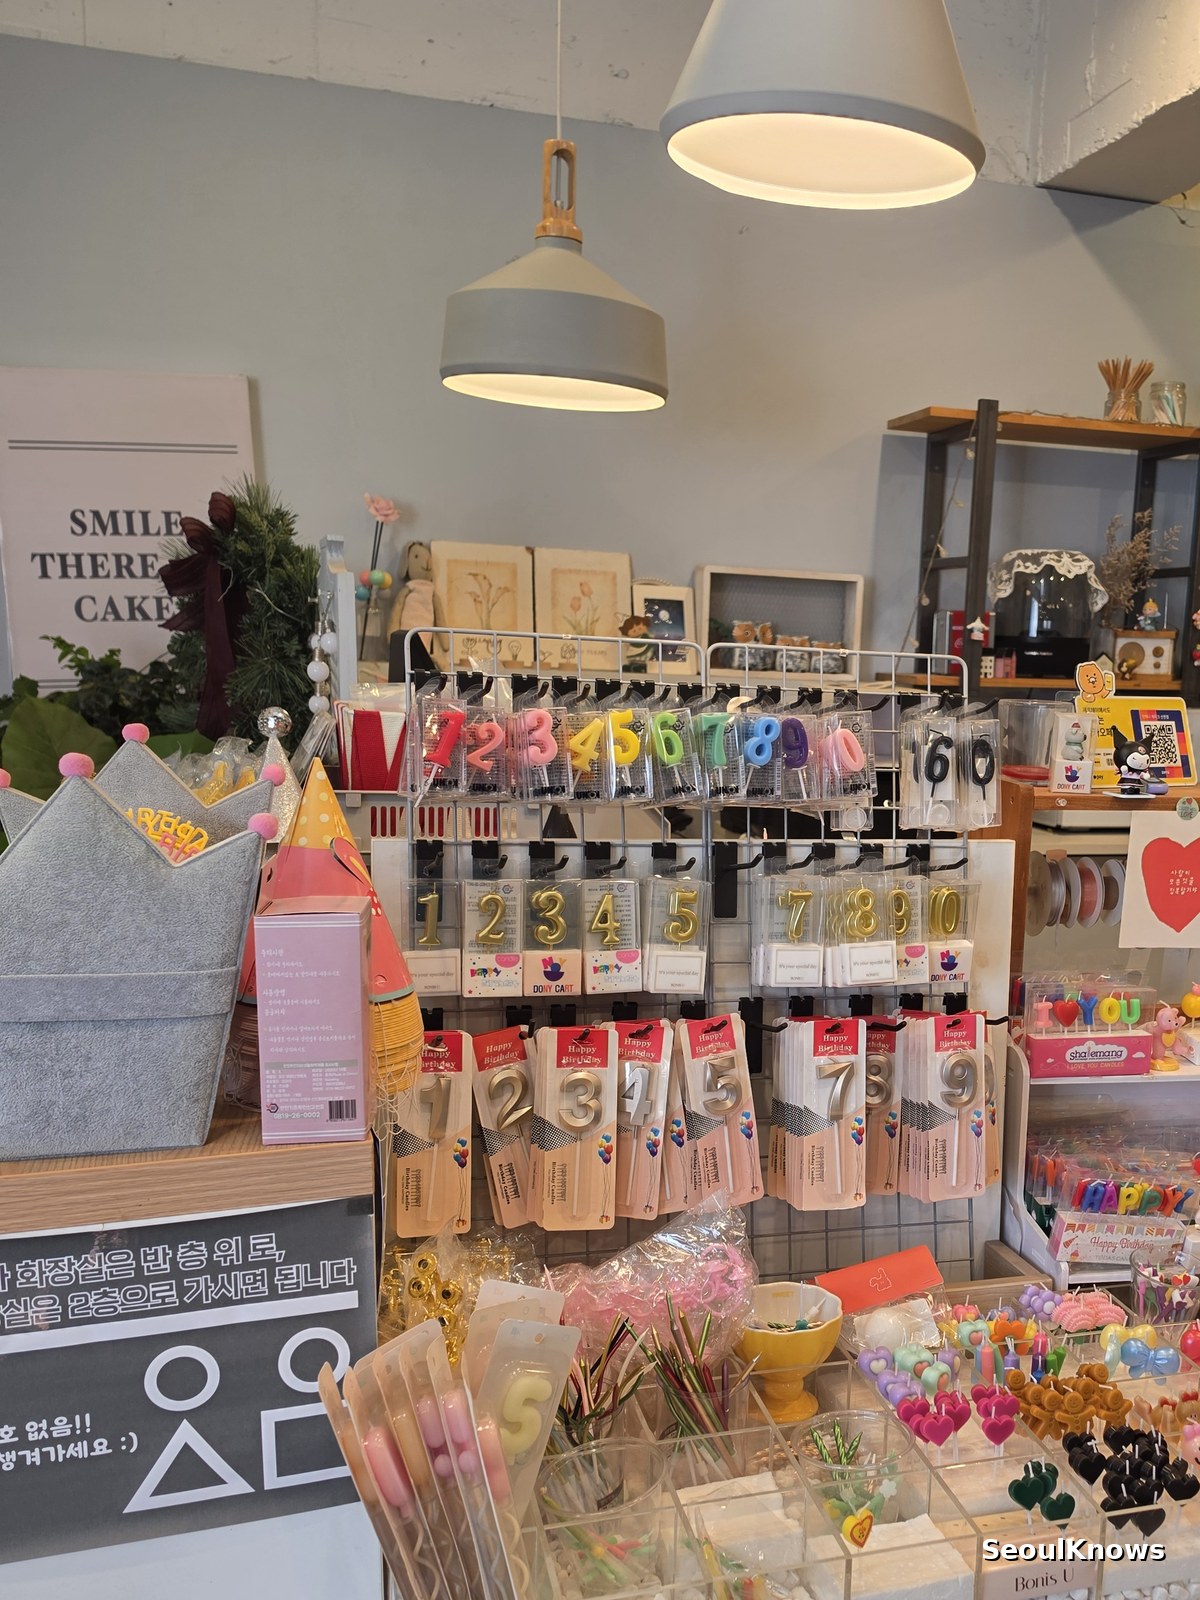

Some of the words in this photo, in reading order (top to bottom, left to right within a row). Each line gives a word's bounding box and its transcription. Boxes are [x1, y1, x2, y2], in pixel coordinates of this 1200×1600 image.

[70, 508, 184, 537] SMILE
[74, 594, 175, 623] CAKE
[524, 708, 558, 766] 3
[569, 718, 604, 772] 4
[608, 708, 641, 766] 5
[653, 711, 684, 765] 6
[745, 716, 781, 766] 8
[924, 735, 954, 784] 6
[418, 894, 442, 945] 1
[475, 893, 506, 944] 2
[534, 890, 568, 944] 3
[591, 893, 621, 945] 4
[663, 890, 698, 943] 5
[787, 889, 814, 941] 7
[533, 984, 553, 994] DONY
[555, 984, 574, 993] CART
[931, 974, 948, 982] DONY
[949, 973, 965, 981] CART
[1078, 995, 1141, 1026] YOU
[485, 1041, 513, 1053] Happy
[624, 1037, 652, 1048] Happy
[695, 1040, 731, 1053] Birthday
[698, 1030, 725, 1042] Happy
[818, 1043, 853, 1052] Birthday
[823, 1034, 849, 1043] Happy
[866, 1041, 890, 1050] thday
[867, 1032, 886, 1040] appy
[939, 1039, 971, 1048] Birthday
[943, 1030, 967, 1038] Happy
[421, 1050, 451, 1059] Happy
[484, 1051, 520, 1065] Birthday
[562, 1055, 602, 1065] Birthday
[568, 1044, 598, 1054] Happy
[618, 1047, 656, 1059] Birthday
[421, 1060, 456, 1070] irthday
[702, 1056, 743, 1116] 5
[815, 1061, 855, 1122] 7
[940, 1052, 978, 1108] 9
[420, 1076, 451, 1139] 1
[488, 1069, 533, 1130] 2
[559, 1070, 601, 1128] 3
[1080, 1180, 1186, 1218] HAPPY
[1090, 1236, 1118, 1253] Happy
[1120, 1237, 1154, 1253] Birthday
[16, 1249, 135, 1288] 화장실은
[141, 1245, 172, 1275] 반
[177, 1240, 208, 1269] 층
[214, 1236, 242, 1265] 위
[0, 1294, 62, 1329] 실은
[68, 1280, 179, 1319] 2층으로
[184, 1271, 269, 1304] 가시면
[275, 1257, 357, 1294] 됩니다
[25, 1413, 91, 1442] 없음!!
[1014, 1568, 1058, 1593] Bonis
[1062, 1567, 1075, 1584] U
